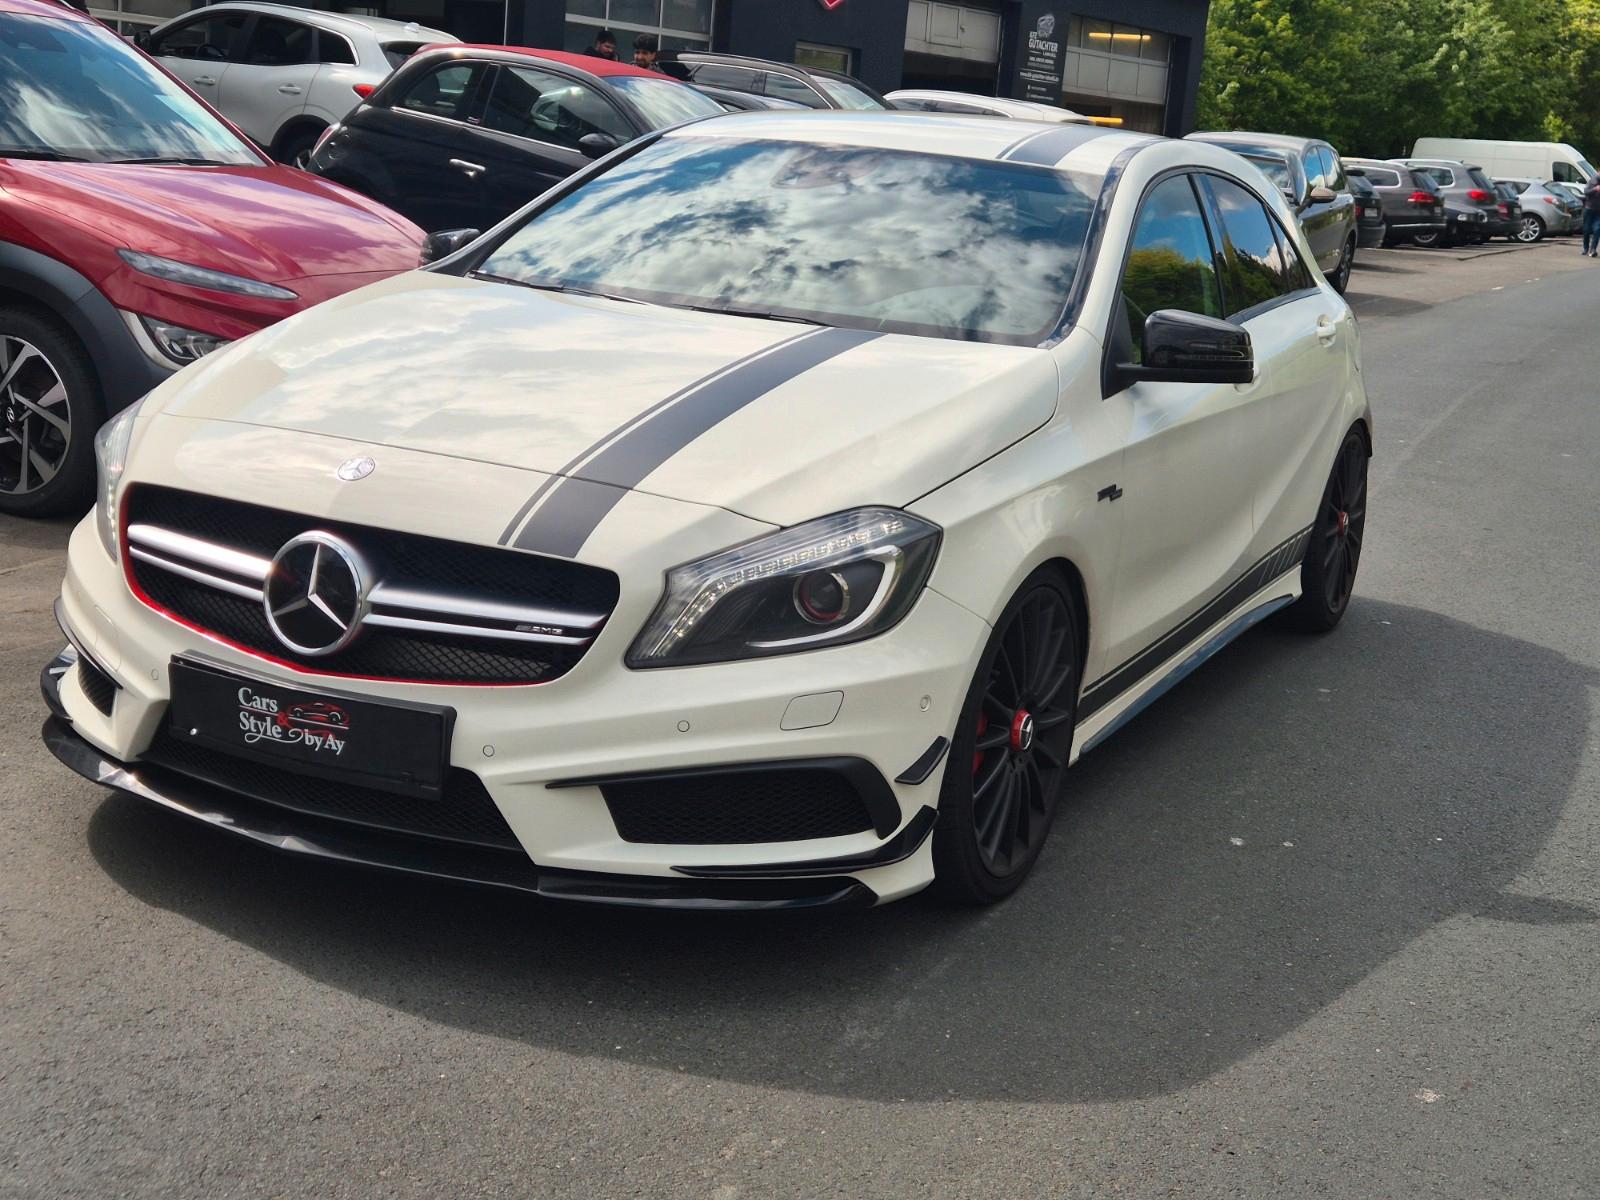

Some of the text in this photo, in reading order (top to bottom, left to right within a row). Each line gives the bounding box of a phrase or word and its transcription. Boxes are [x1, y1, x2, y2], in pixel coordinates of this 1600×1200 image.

[1028, 38, 1058, 52] GUTACHTER
[238, 687, 277, 712] Cars
[239, 711, 345, 755] Style by Ay
